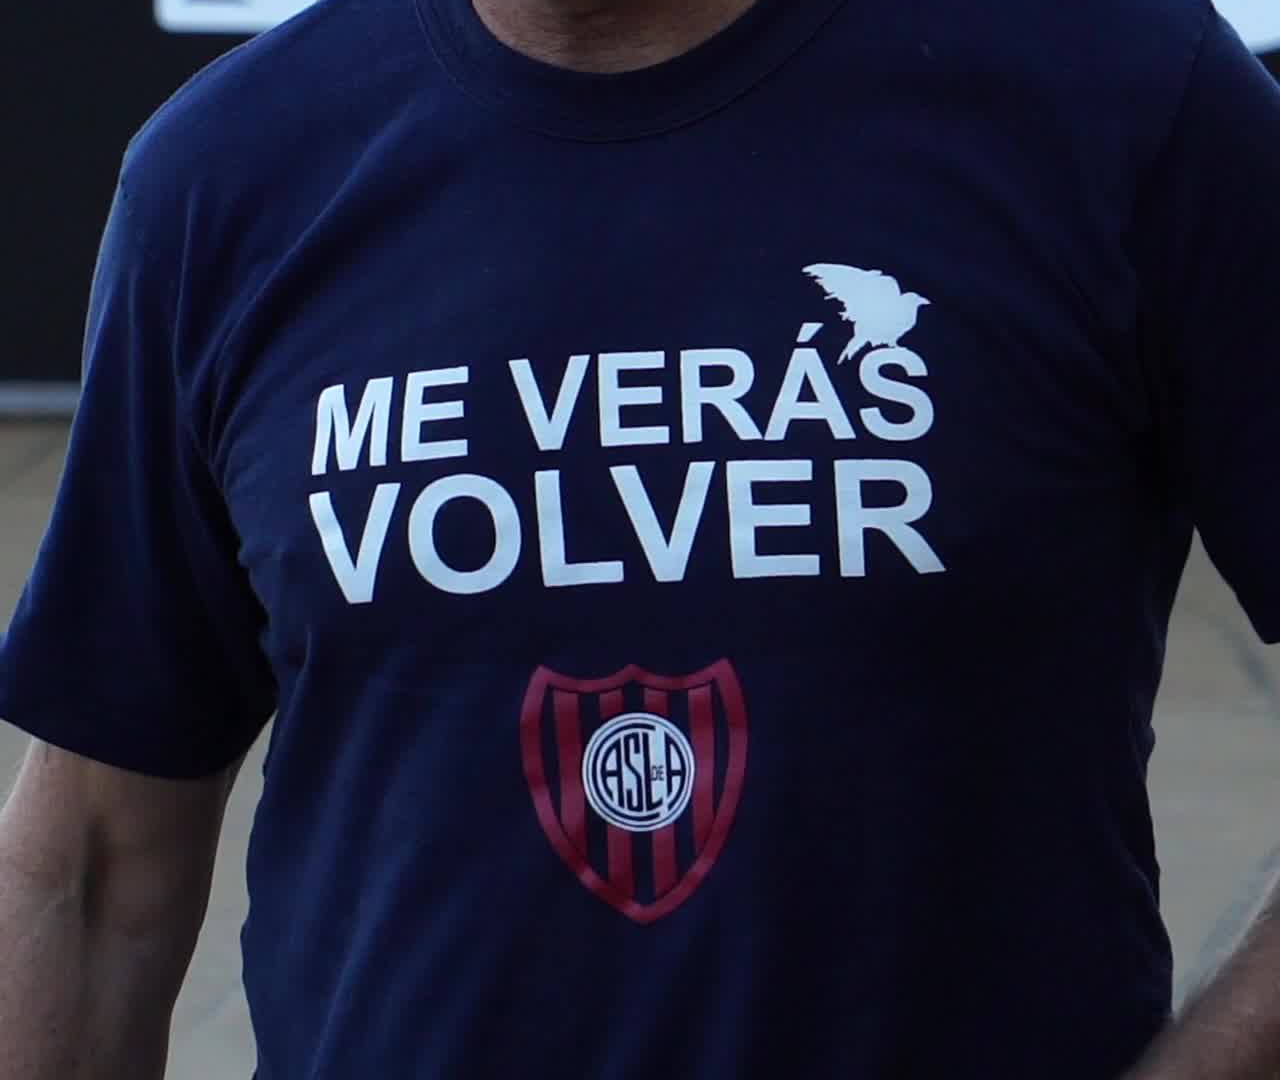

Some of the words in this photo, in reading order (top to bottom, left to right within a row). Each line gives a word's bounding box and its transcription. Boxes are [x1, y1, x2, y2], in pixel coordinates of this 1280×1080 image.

[311, 365, 470, 476] ME
[508, 322, 935, 451] VERÁS
[308, 458, 947, 605] VOLVER
